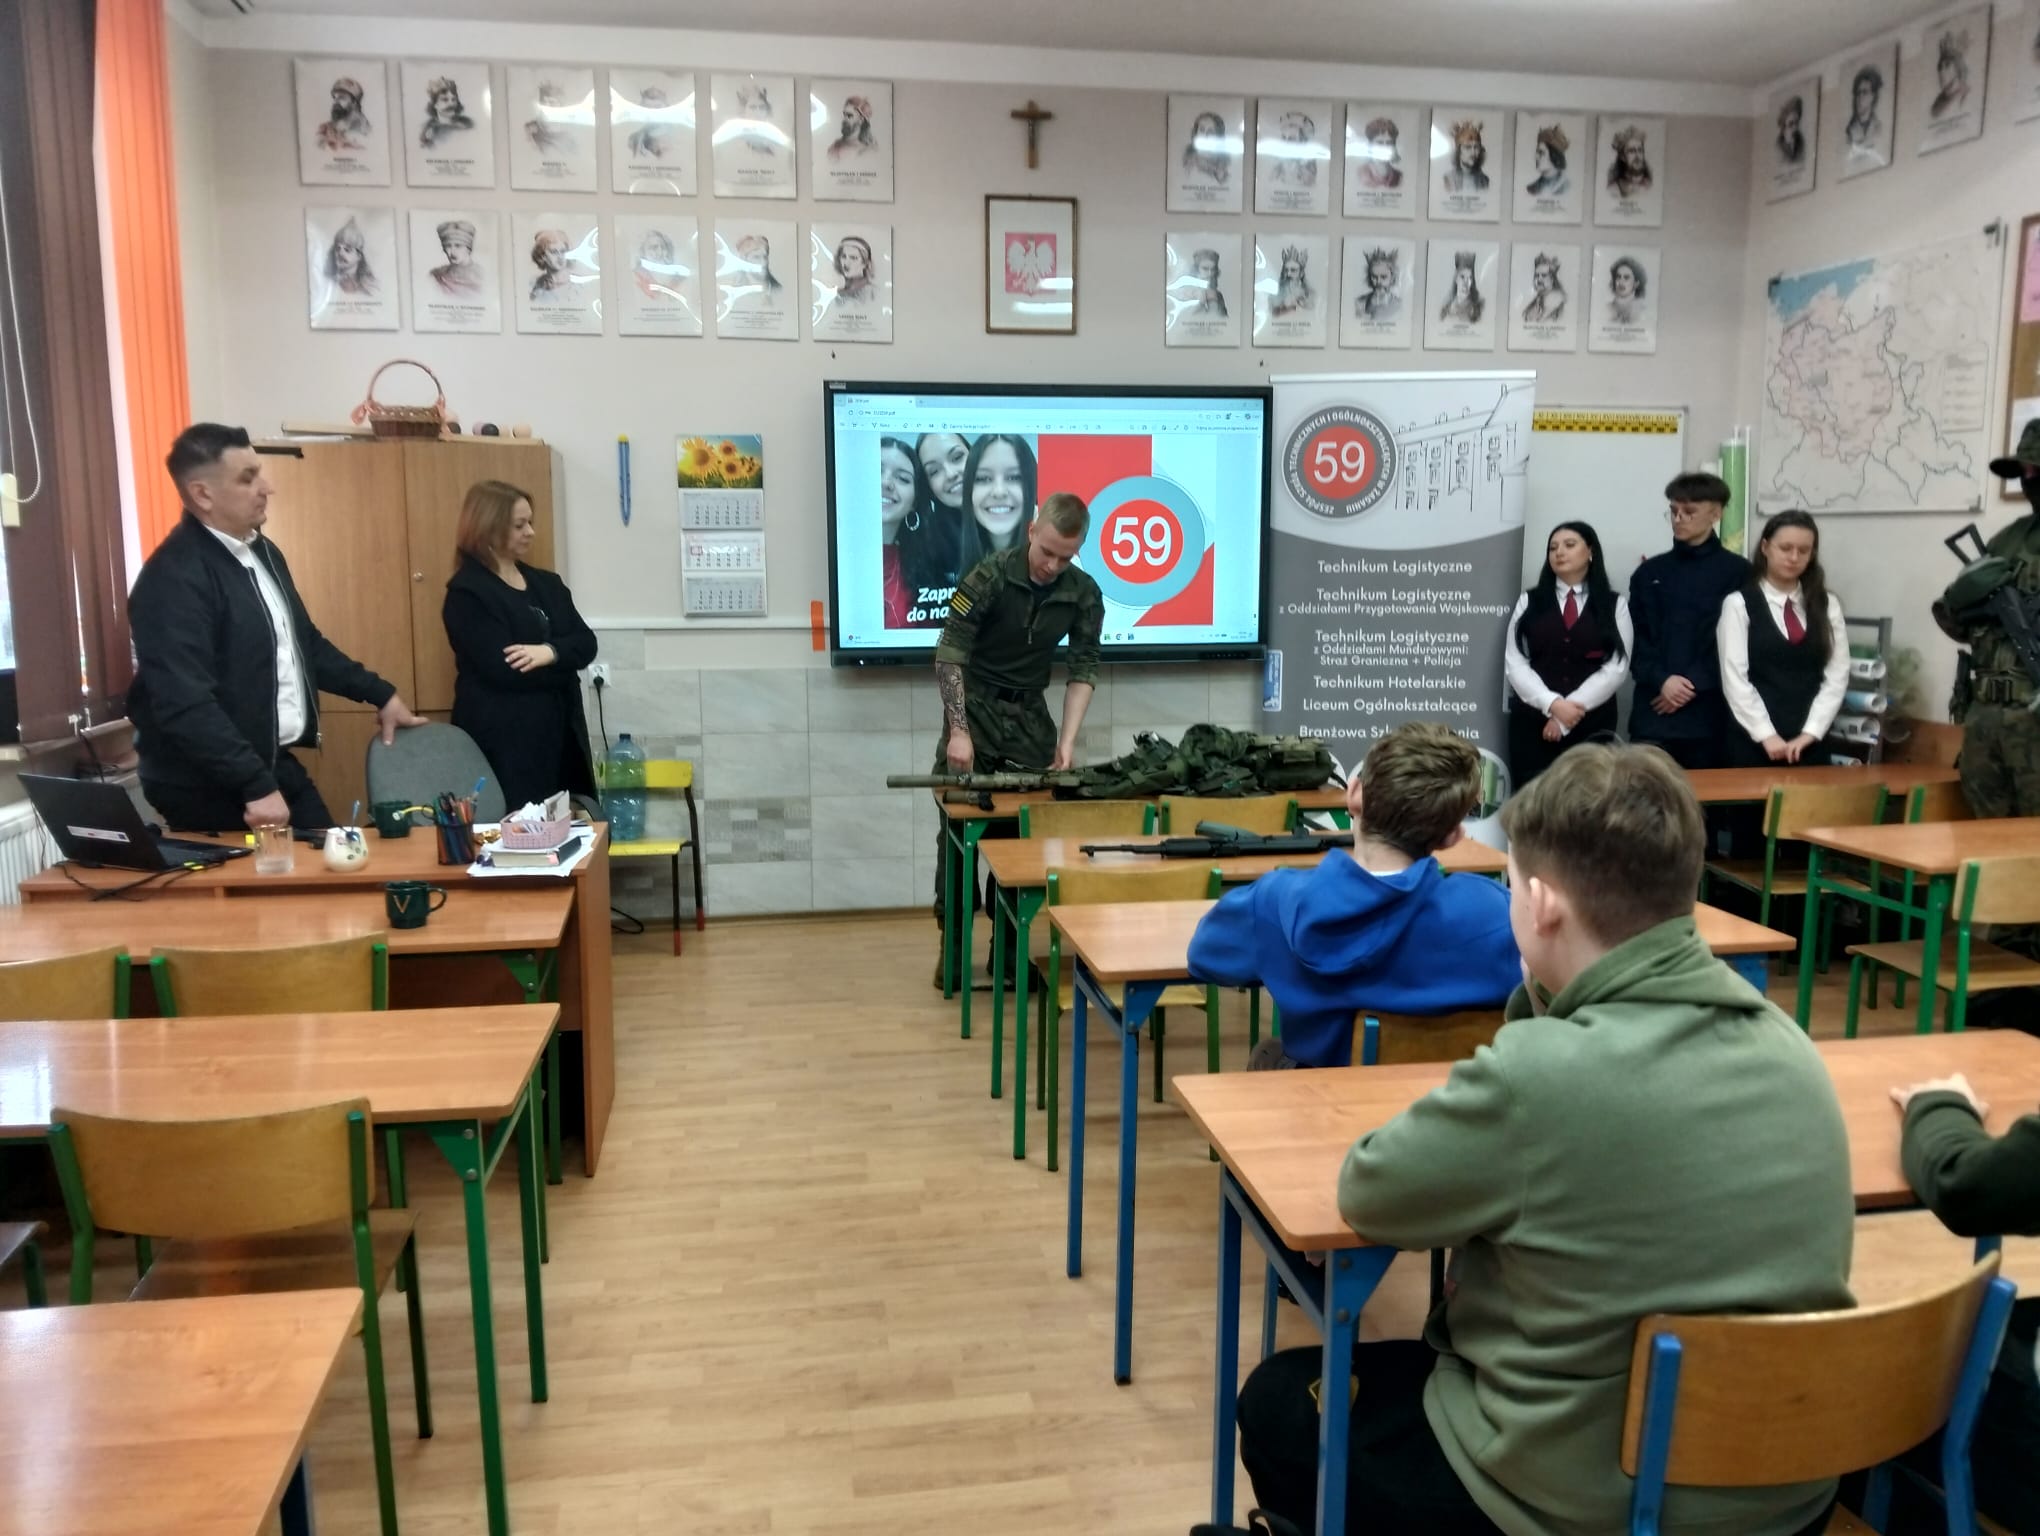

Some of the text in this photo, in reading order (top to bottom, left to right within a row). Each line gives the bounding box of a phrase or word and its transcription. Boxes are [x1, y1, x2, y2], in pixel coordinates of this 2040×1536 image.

[1314, 440, 1366, 484] 59
[1111, 516, 1173, 567] 59
[1317, 558, 1472, 577] Technikum Logistyczne
[1316, 586, 1471, 604] Technikum Logistyczne
[906, 606, 927, 623] do
[1279, 602, 1510, 617] z Oddziałami Przygotowania Wojskowego
[1315, 628, 1469, 646] Technikum Logistyczne
[1314, 643, 1469, 657] z Oddziałami Mundurowymi:
[1320, 654, 1348, 666] Straż
[1352, 655, 1408, 666] Graniczna
[1424, 655, 1461, 669] Policja
[1313, 674, 1466, 689] Technikum Hotelarskie
[1303, 698, 1477, 715] Liceum Ogólnokształcące
[1299, 725, 1366, 739] Branżowa
[393, 895, 411, 914] V
